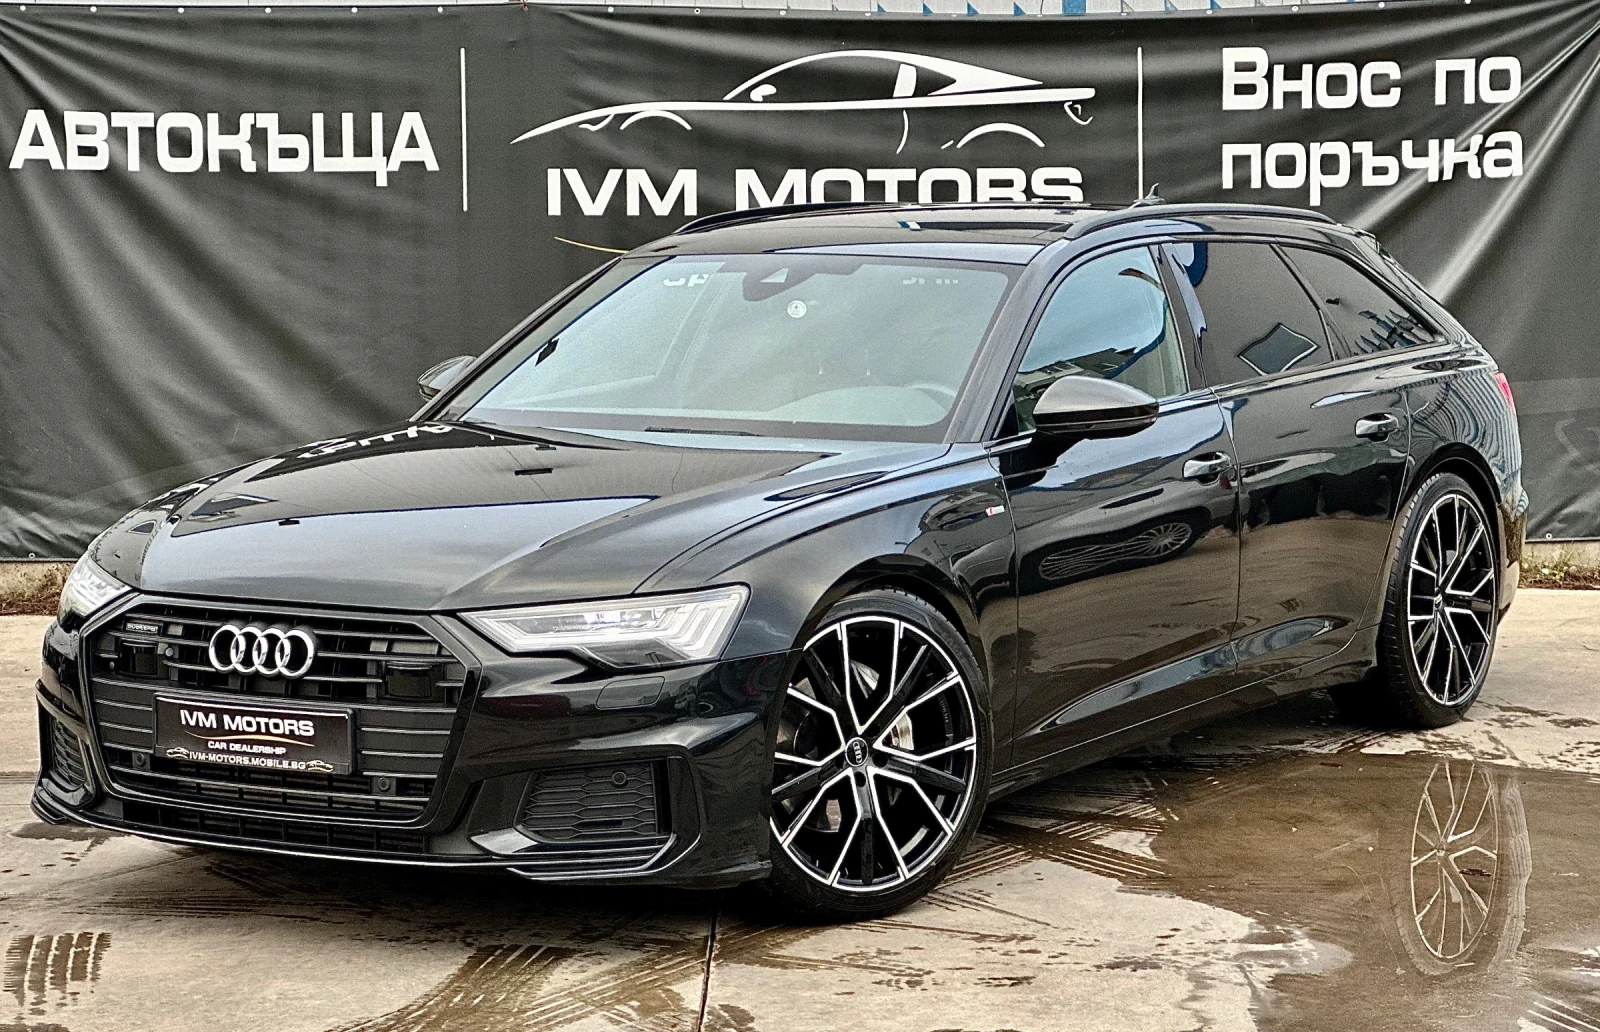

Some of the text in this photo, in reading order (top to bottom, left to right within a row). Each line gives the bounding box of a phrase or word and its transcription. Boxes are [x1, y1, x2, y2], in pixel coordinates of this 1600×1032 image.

[1221, 46, 1523, 111] Внос по
[9, 109, 440, 187] АВТОКЪЩА
[1221, 130, 1524, 206] поръчка
[547, 167, 1083, 217] IVM MOTORS
[180, 709, 315, 736] IVM MOTORS
[208, 740, 286, 755] CAR DEALERSHIP
[189, 752, 306, 769] IVM-MOTORS.MOBILE.BG
